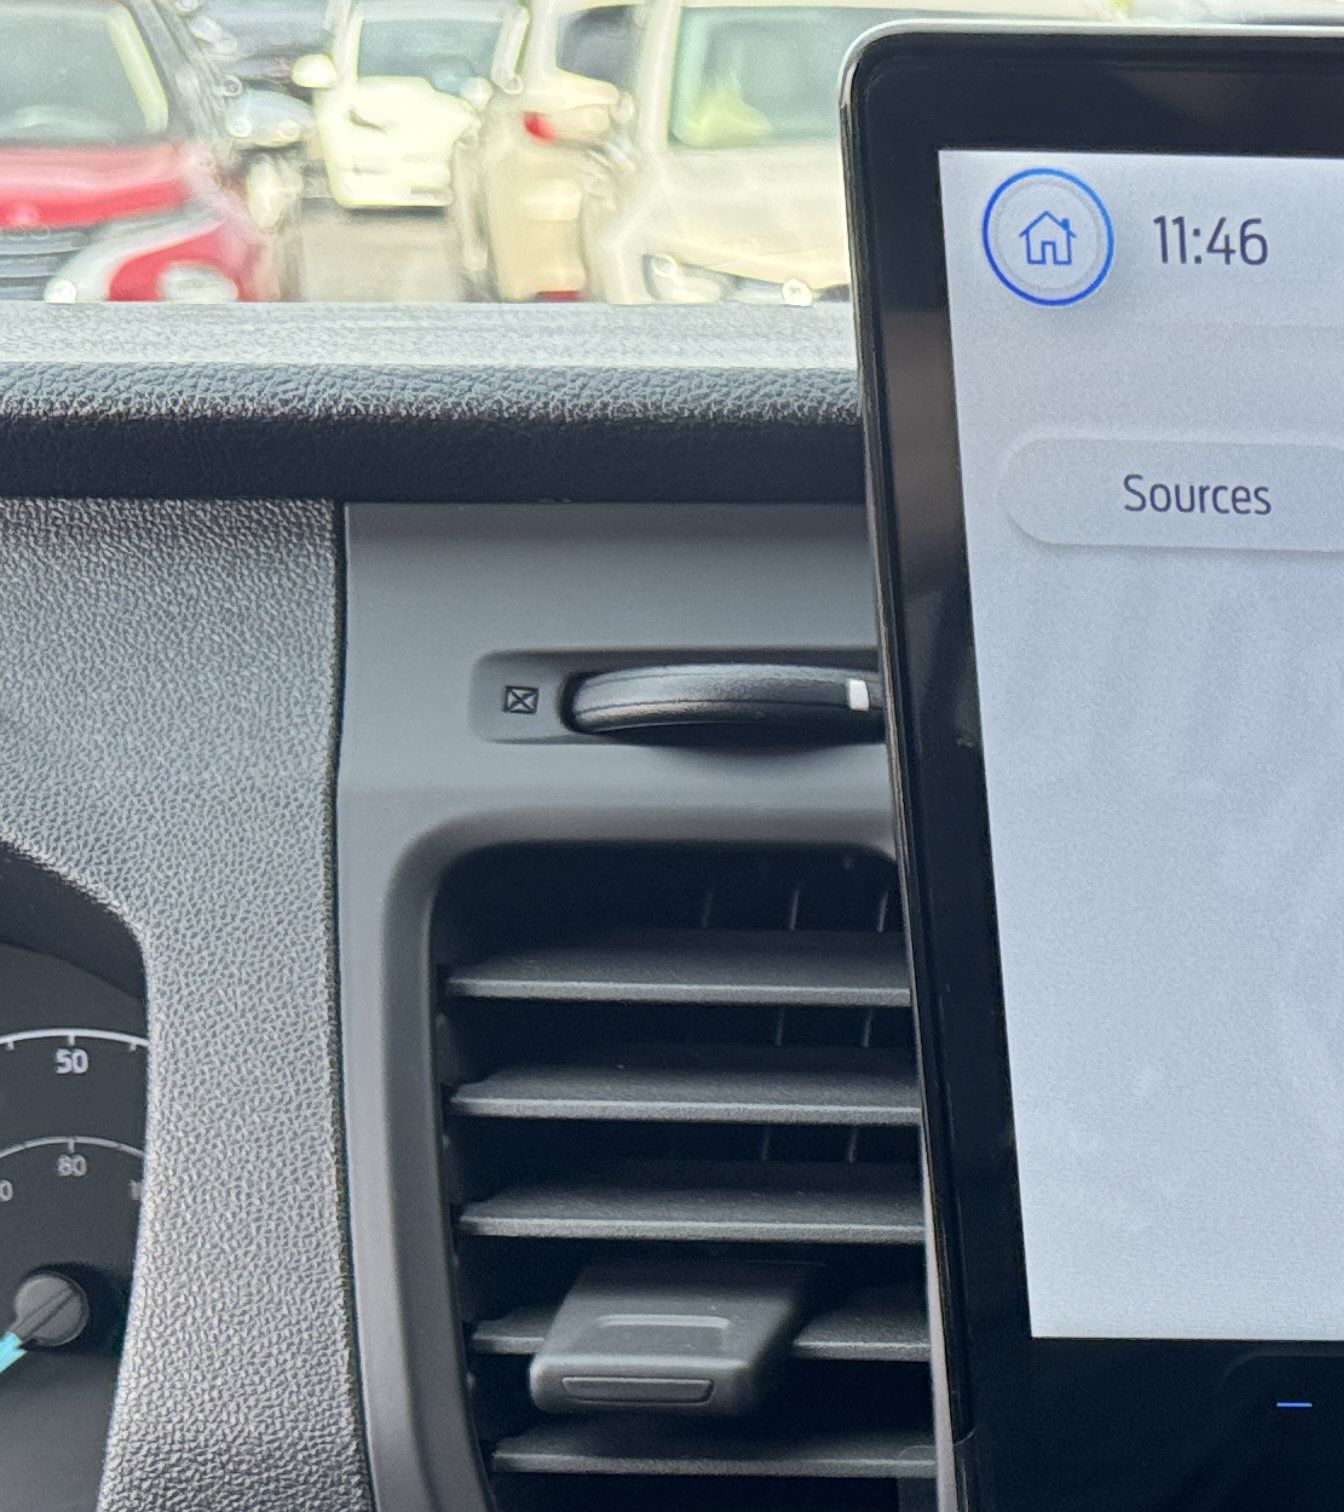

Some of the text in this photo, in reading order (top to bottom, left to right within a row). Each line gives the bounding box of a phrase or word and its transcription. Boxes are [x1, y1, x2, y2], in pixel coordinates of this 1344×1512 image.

[1153, 215, 1268, 266] 11:46
[1123, 473, 1272, 516] Sources
[55, 1048, 89, 1075] 50
